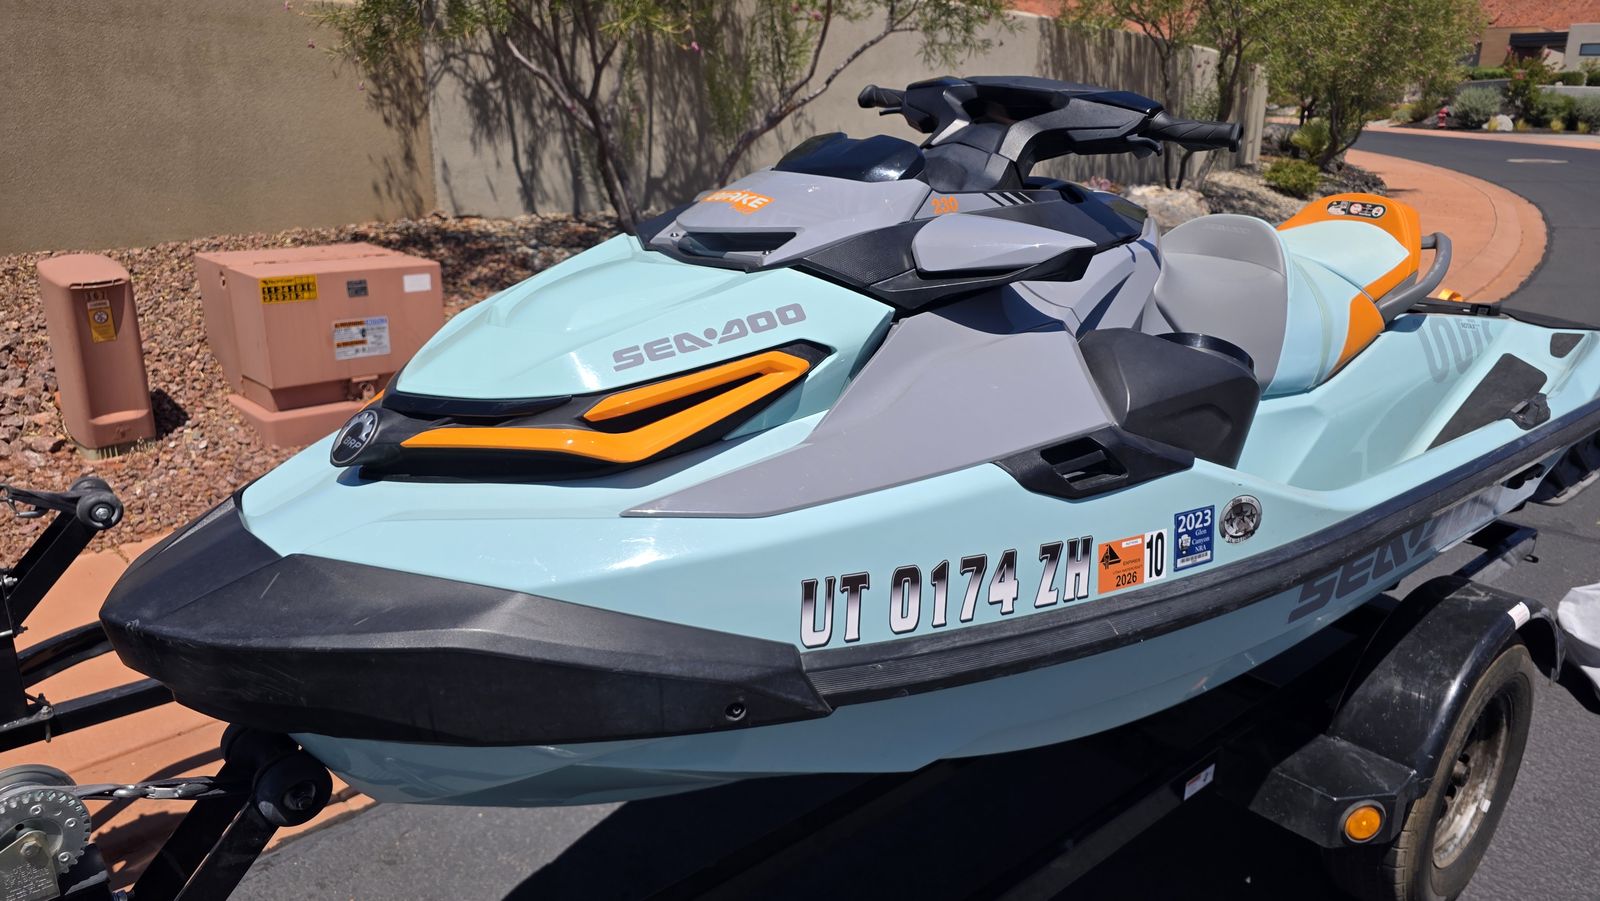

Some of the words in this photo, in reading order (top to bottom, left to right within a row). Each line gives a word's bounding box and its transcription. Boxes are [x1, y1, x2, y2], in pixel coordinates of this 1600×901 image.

[931, 196, 959, 215] 230
[343, 436, 362, 449] BRP
[1178, 509, 1212, 533] 2023
[1192, 536, 1210, 545] Canyon
[1146, 531, 1165, 578] 10
[1116, 571, 1137, 587] 2026
[800, 571, 870, 648] UT
[889, 549, 1019, 634] 0174
[1034, 535, 1093, 608] ZH
